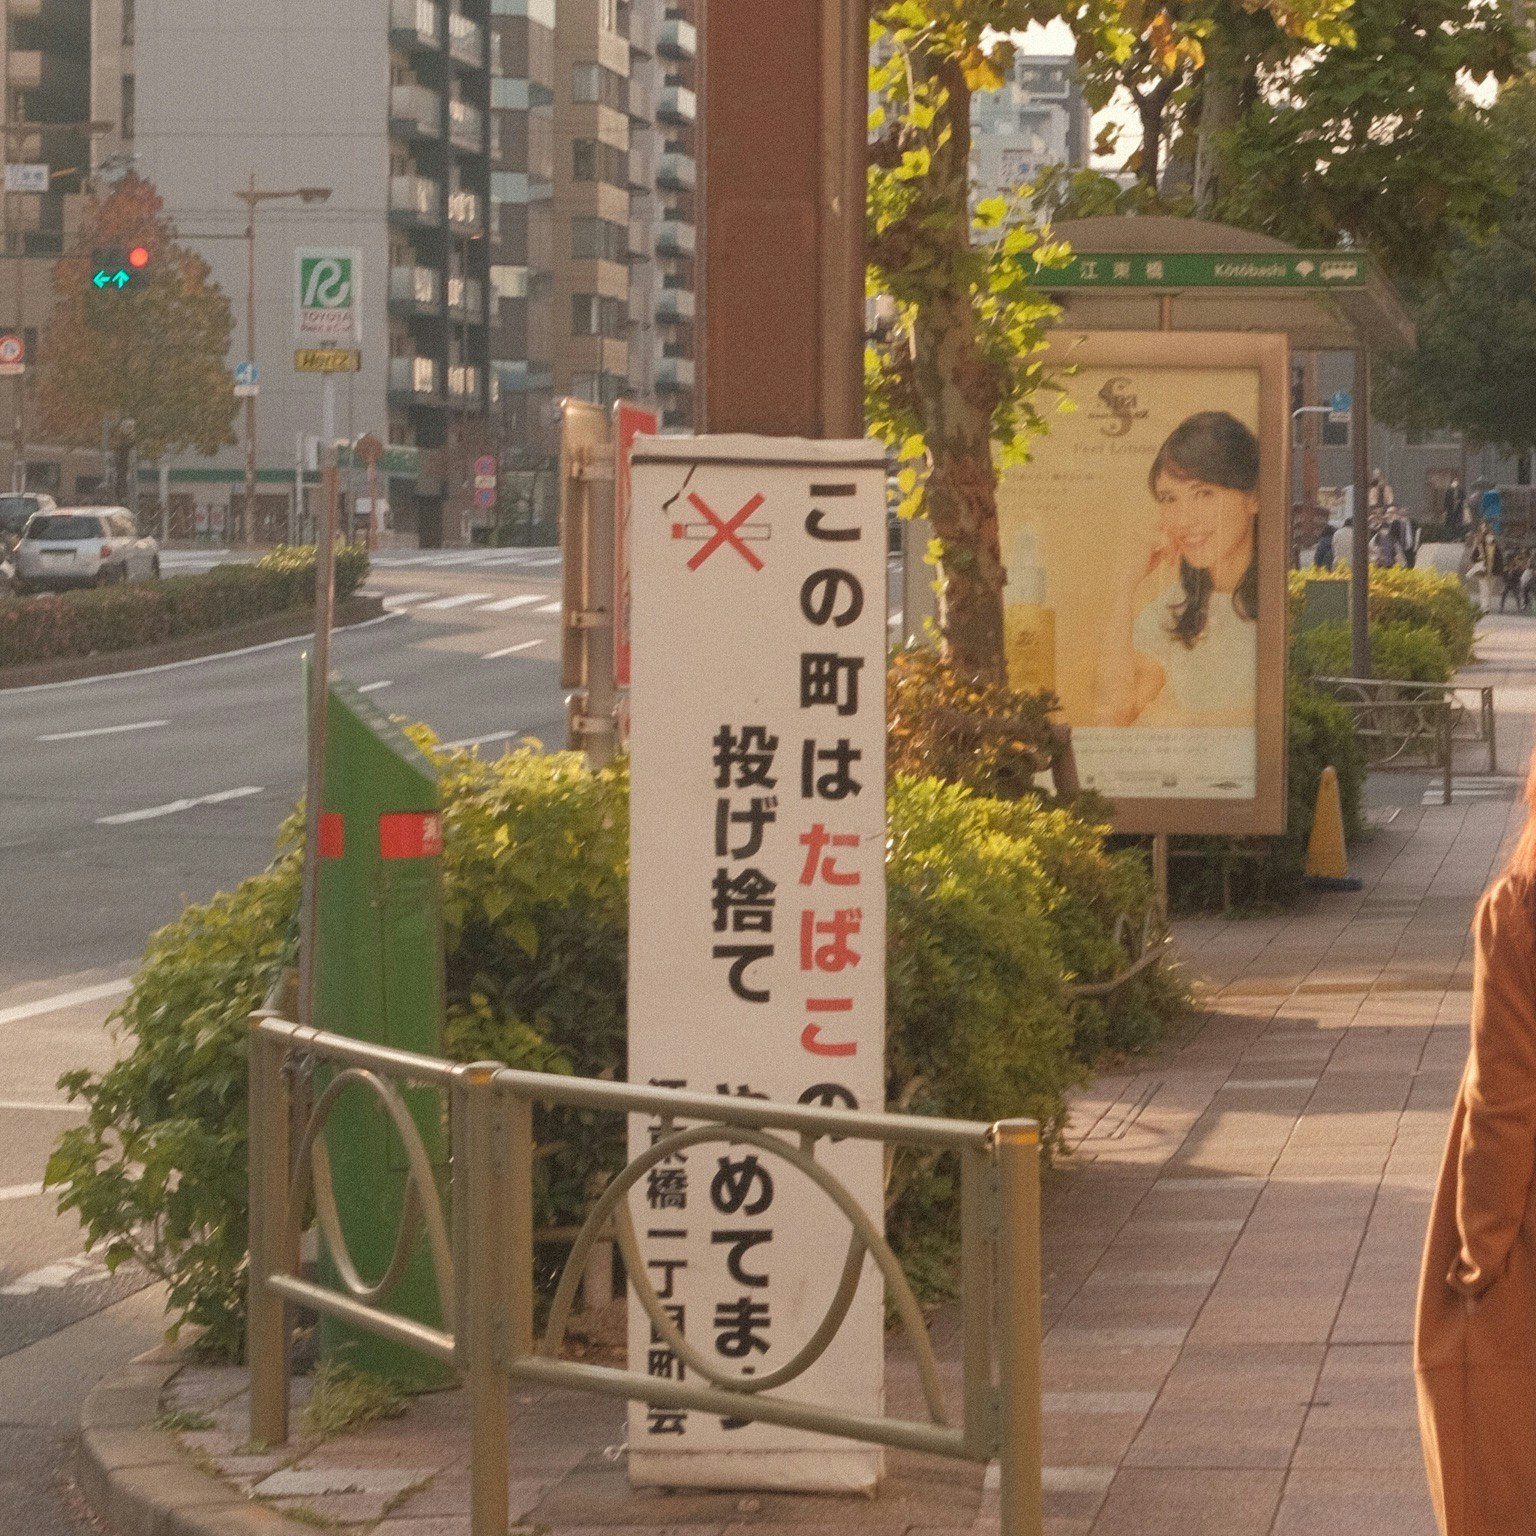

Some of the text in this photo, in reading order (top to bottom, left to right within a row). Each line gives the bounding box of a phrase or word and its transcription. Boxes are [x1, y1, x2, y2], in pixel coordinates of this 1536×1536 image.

[710, 724, 779, 1431] 投げ捨て めてま
